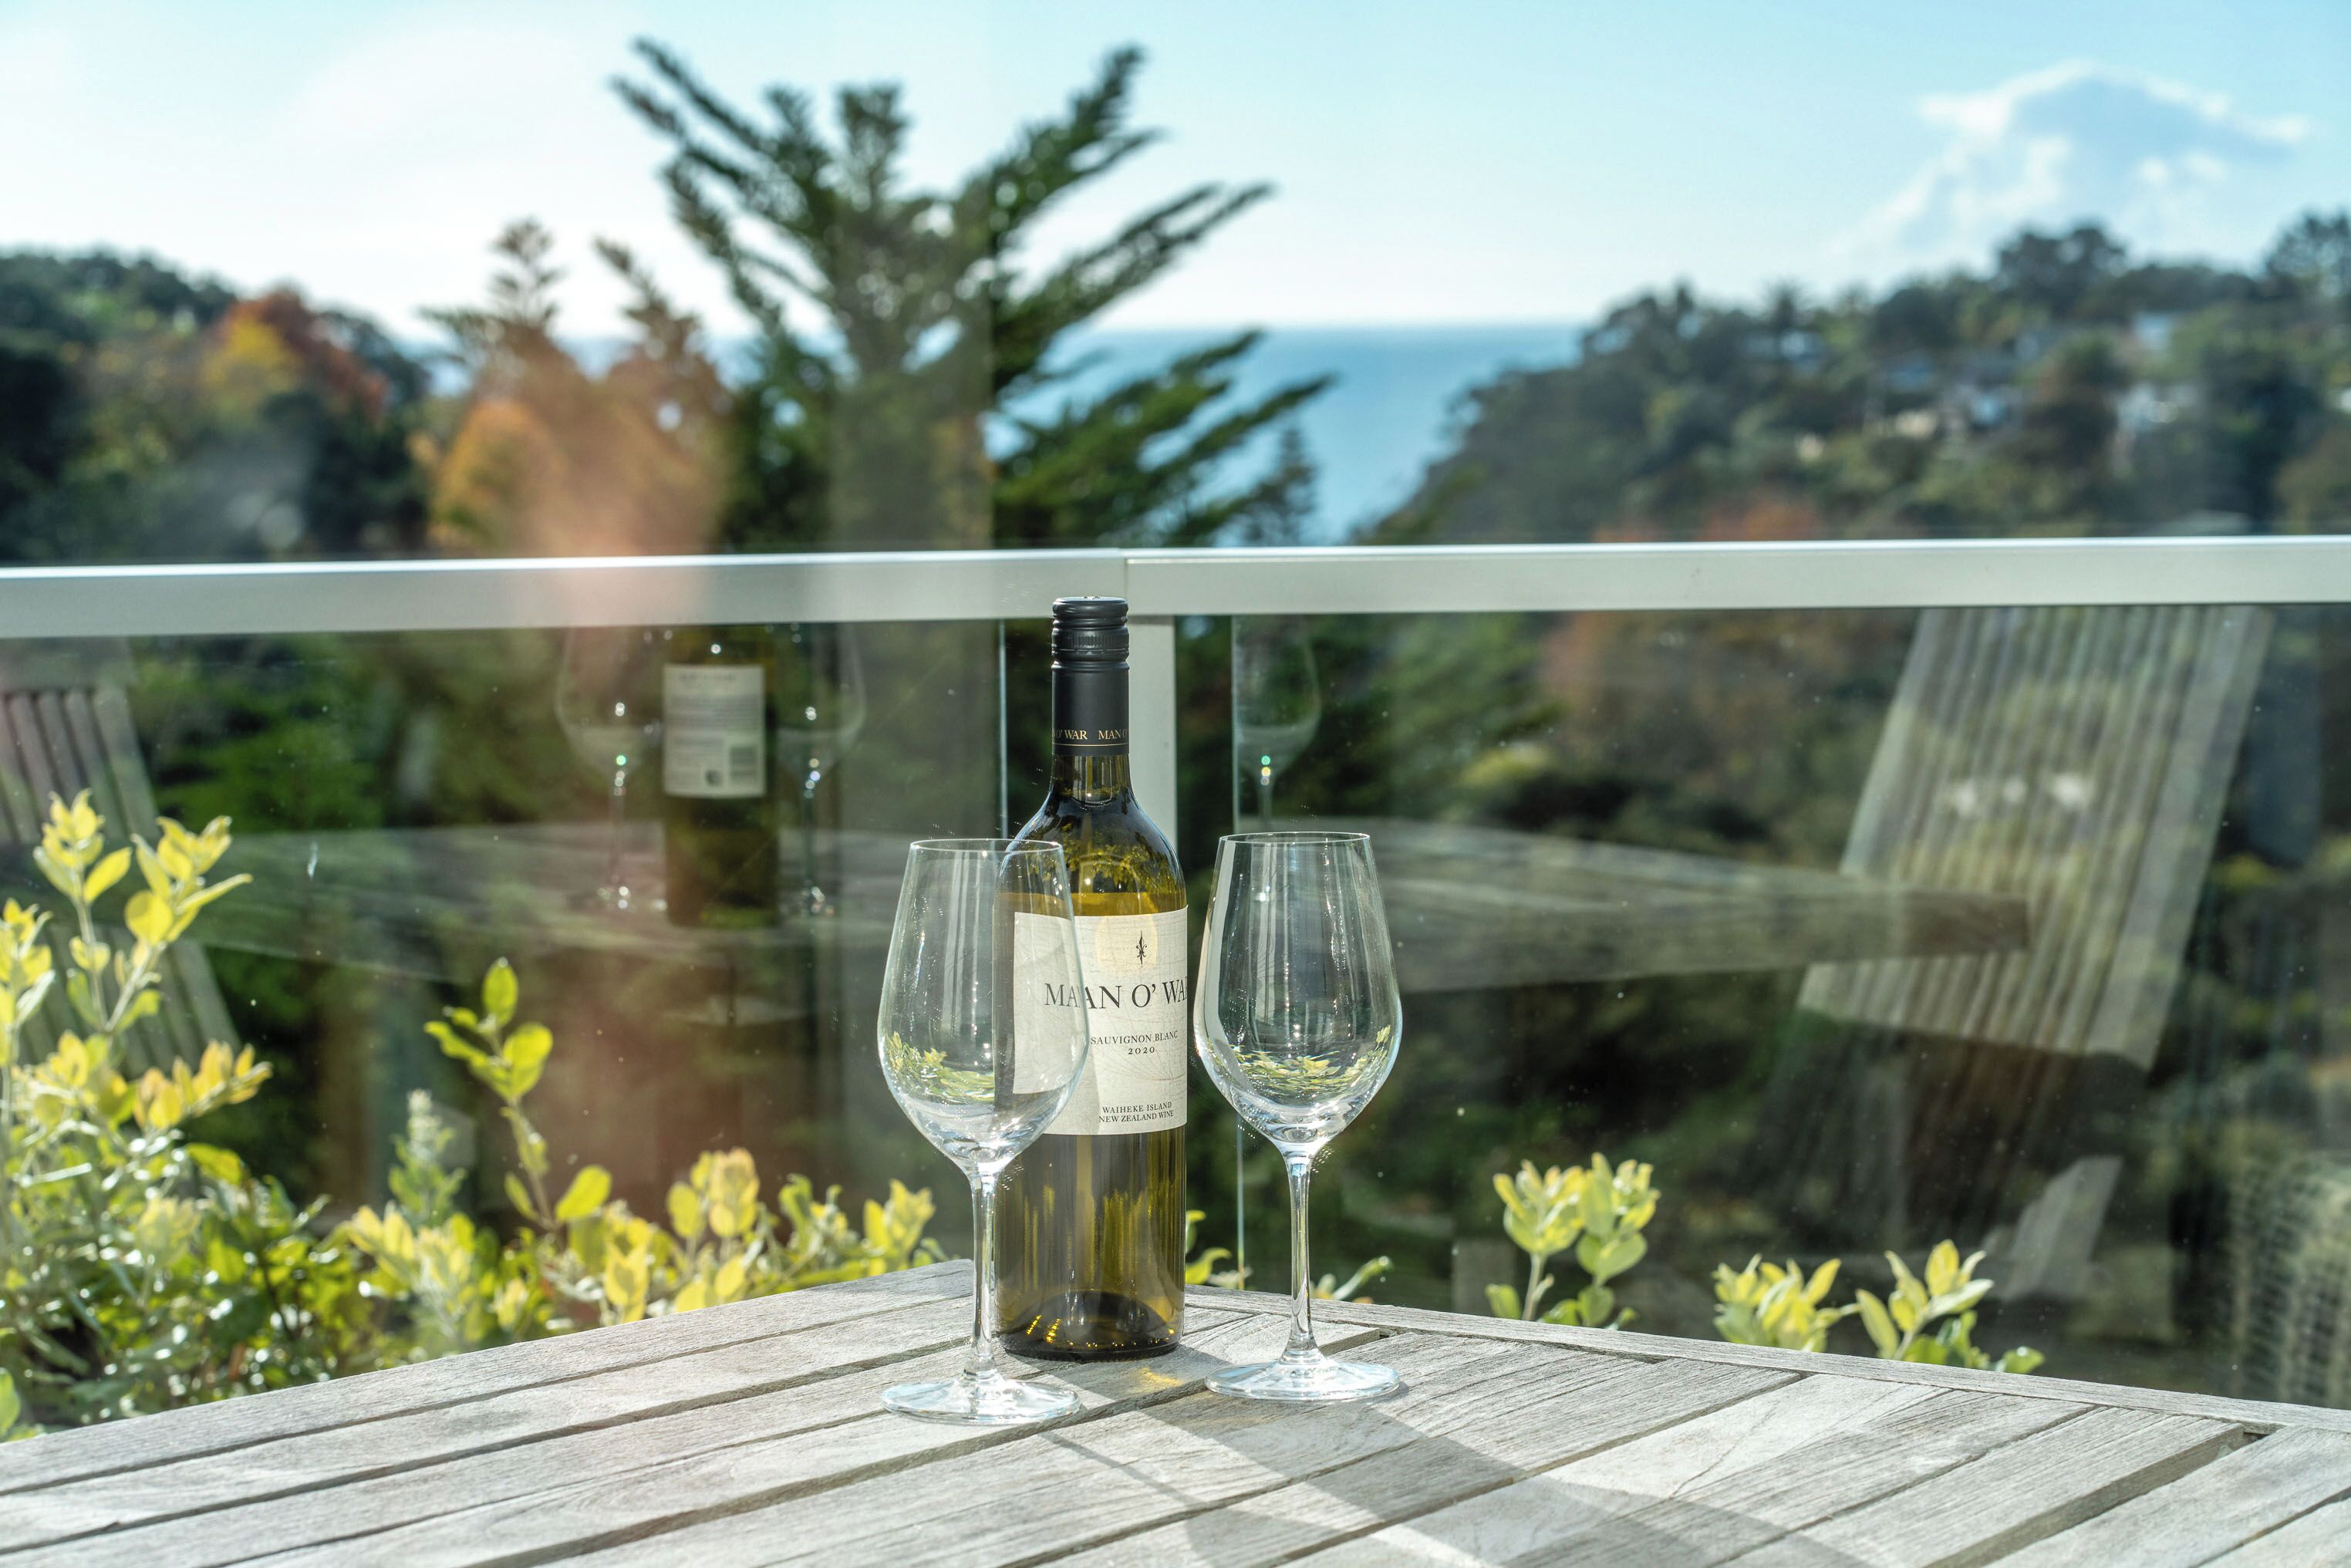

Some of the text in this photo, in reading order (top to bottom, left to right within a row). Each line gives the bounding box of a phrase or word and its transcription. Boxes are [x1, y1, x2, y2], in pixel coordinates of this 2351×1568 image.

[1064, 730, 1088, 740] WAR
[1098, 730, 1122, 740] MAN
[1132, 983, 1155, 1007] O'
[1091, 1030, 1178, 1044] SAUVIGNON BLANC
[1128, 1046, 1155, 1055] 2020
[1147, 1101, 1172, 1111] ISLAND
[1121, 1113, 1157, 1122] ZEALAND
[1159, 1110, 1174, 1118] WINE
